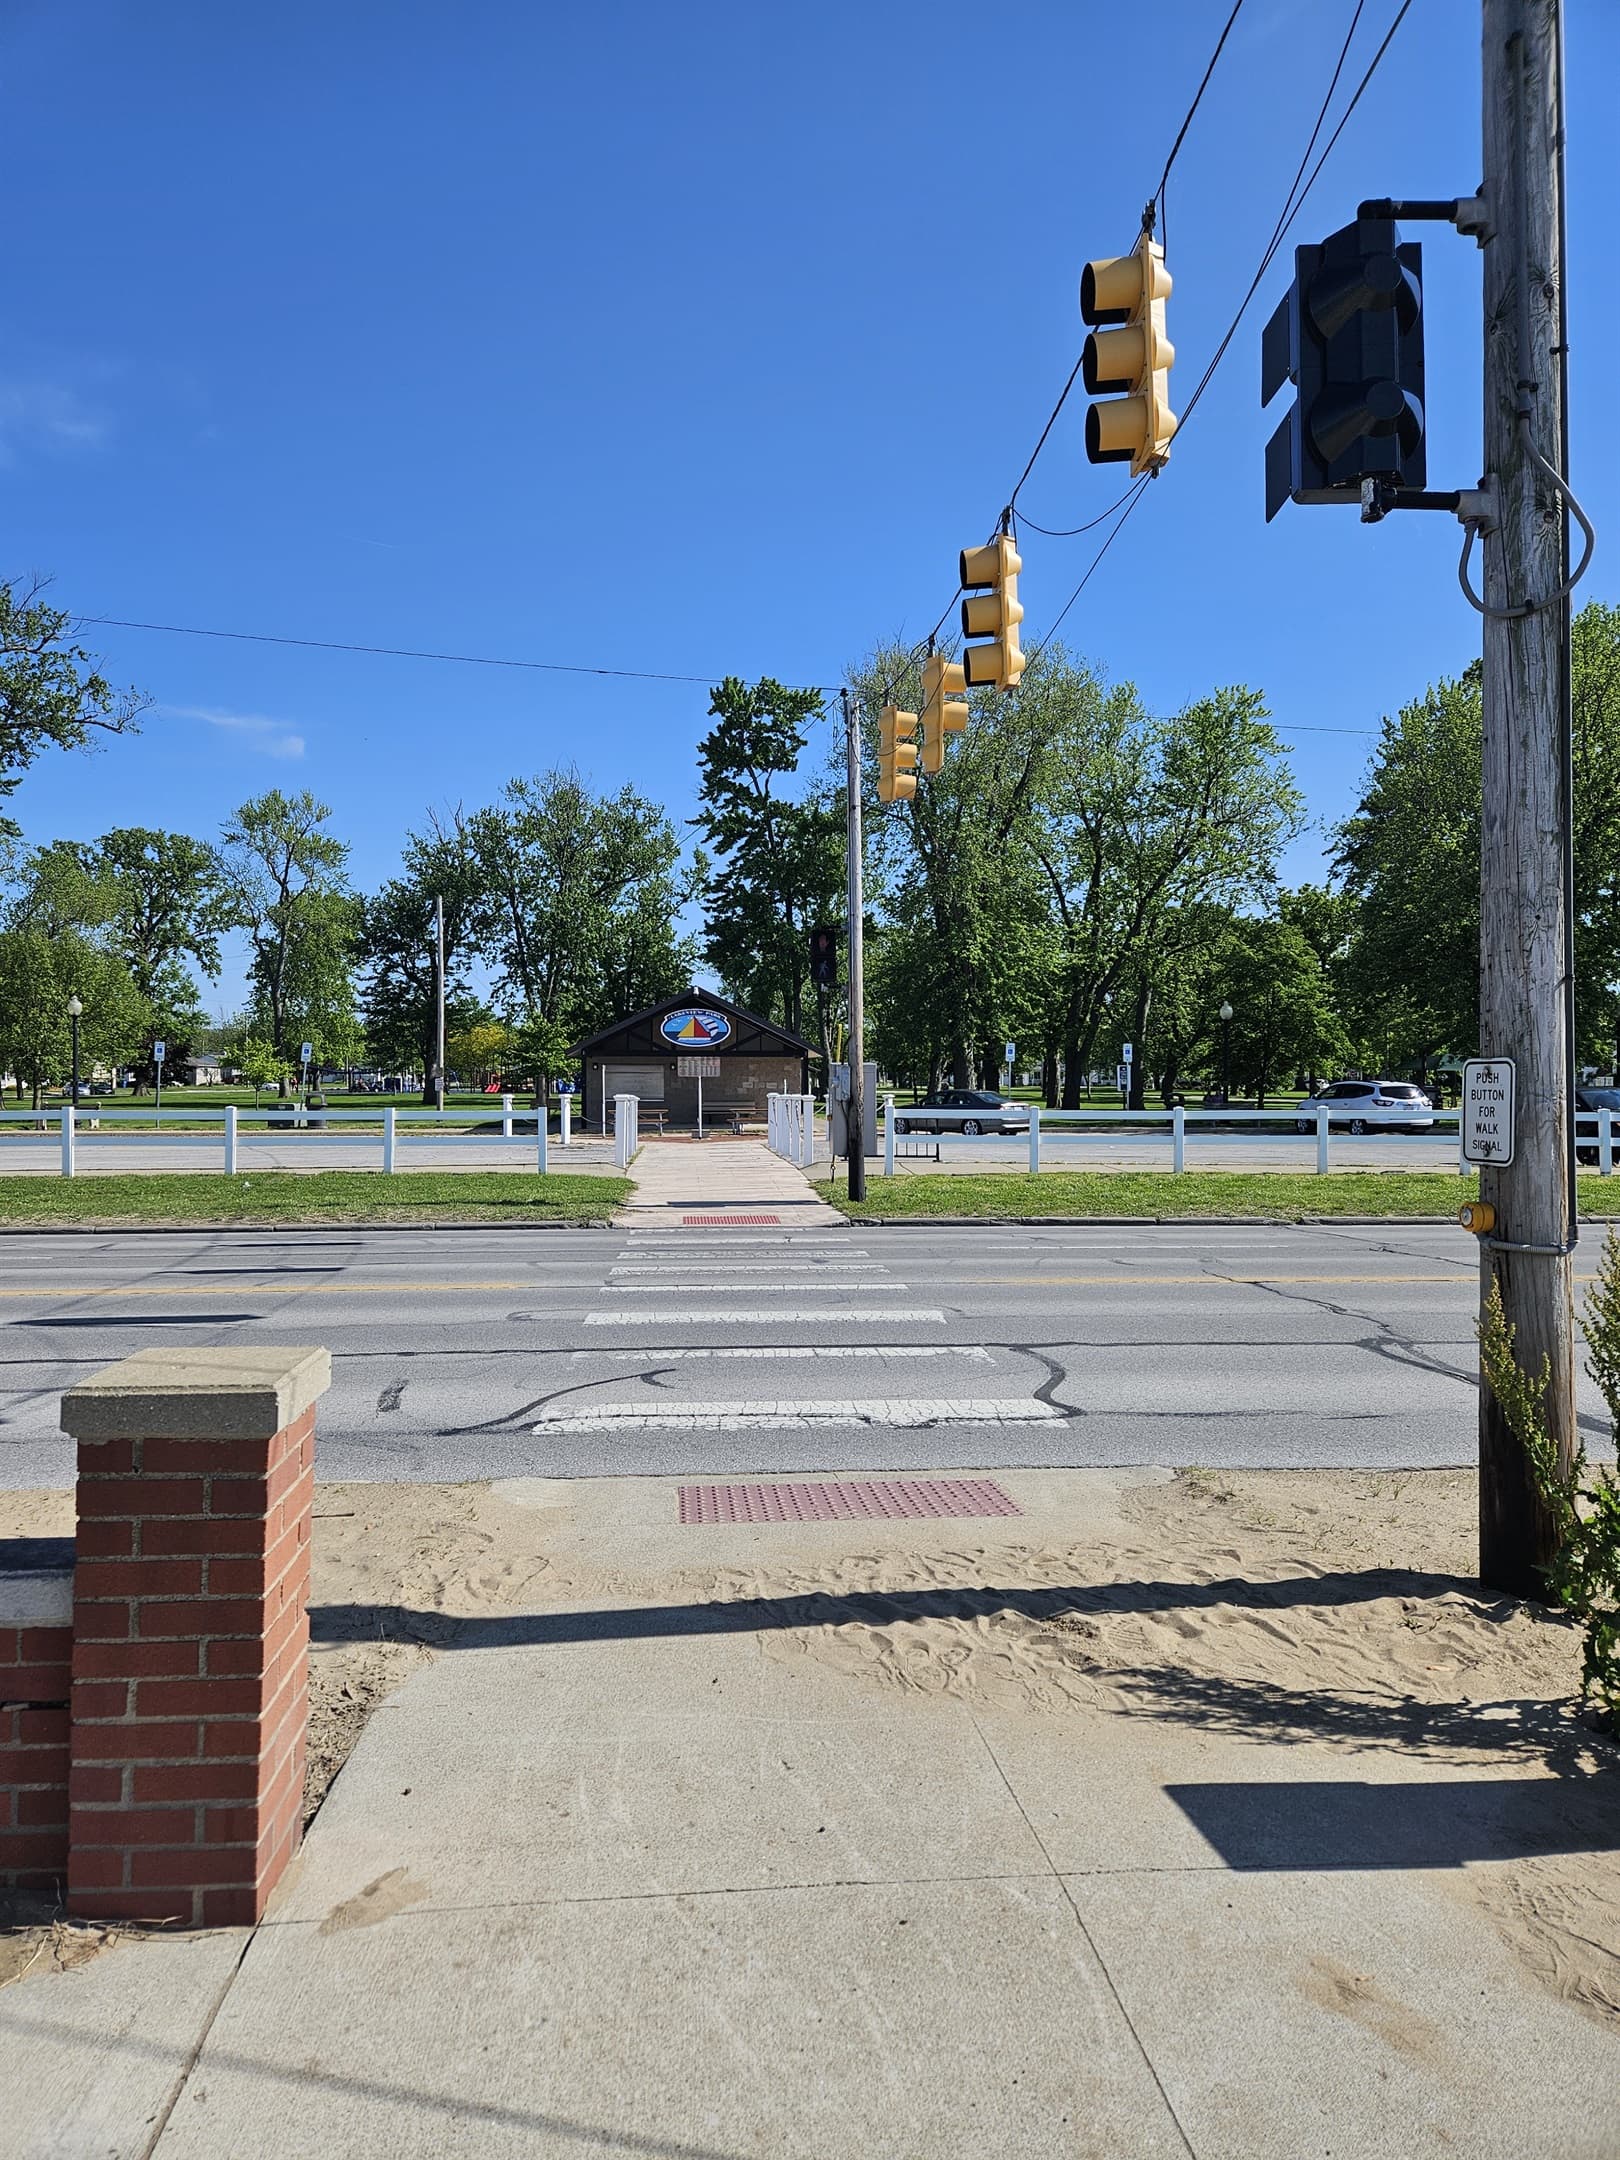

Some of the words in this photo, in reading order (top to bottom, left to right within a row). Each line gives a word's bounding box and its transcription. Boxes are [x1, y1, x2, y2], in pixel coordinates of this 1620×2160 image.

[1476, 1072, 1499, 1084] PUSH
[1471, 1089, 1504, 1101] BUTTON
[1478, 1106, 1496, 1118] FOR
[1475, 1122, 1499, 1135] WALK
[1472, 1139, 1502, 1152] SIGNAL
